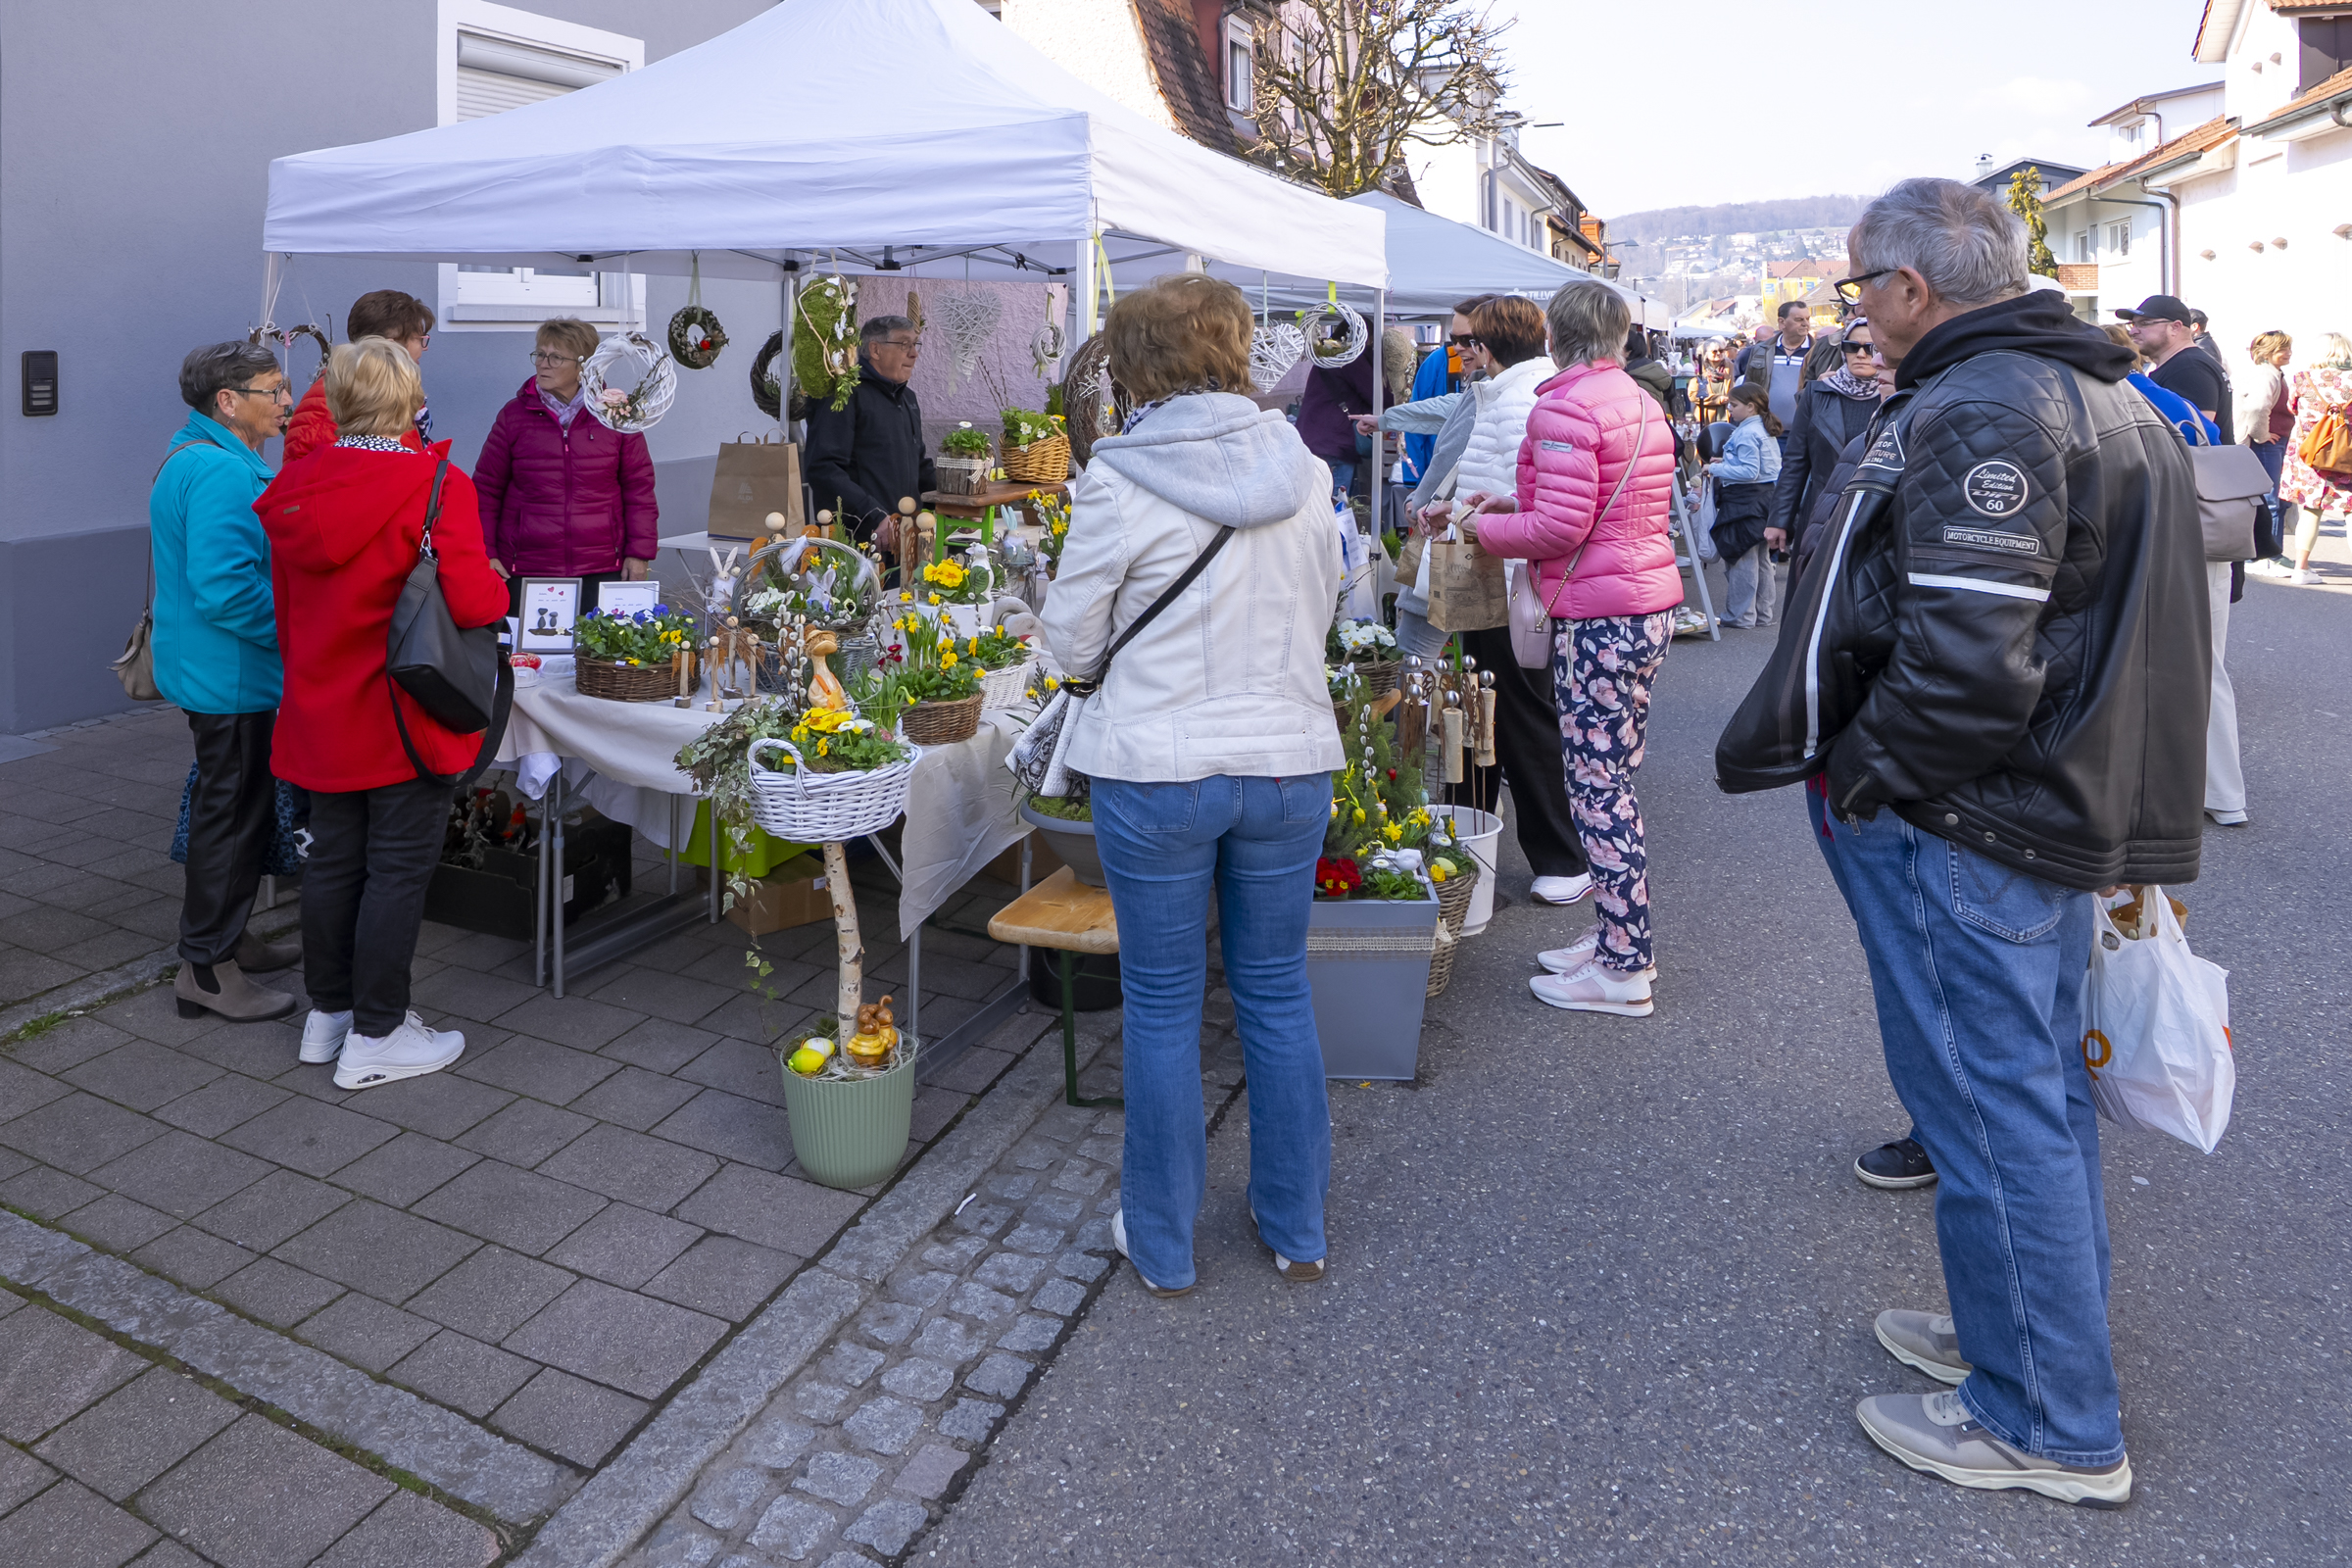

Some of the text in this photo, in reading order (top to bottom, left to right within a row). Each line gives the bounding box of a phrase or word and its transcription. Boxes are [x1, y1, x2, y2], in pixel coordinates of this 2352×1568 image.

[1973, 468, 2019, 482] Limited
[1982, 479, 2015, 491] Edition
[1985, 499, 2004, 512] 60
[1947, 531, 2035, 551] MOTORCYCLE EQUIPMENT
